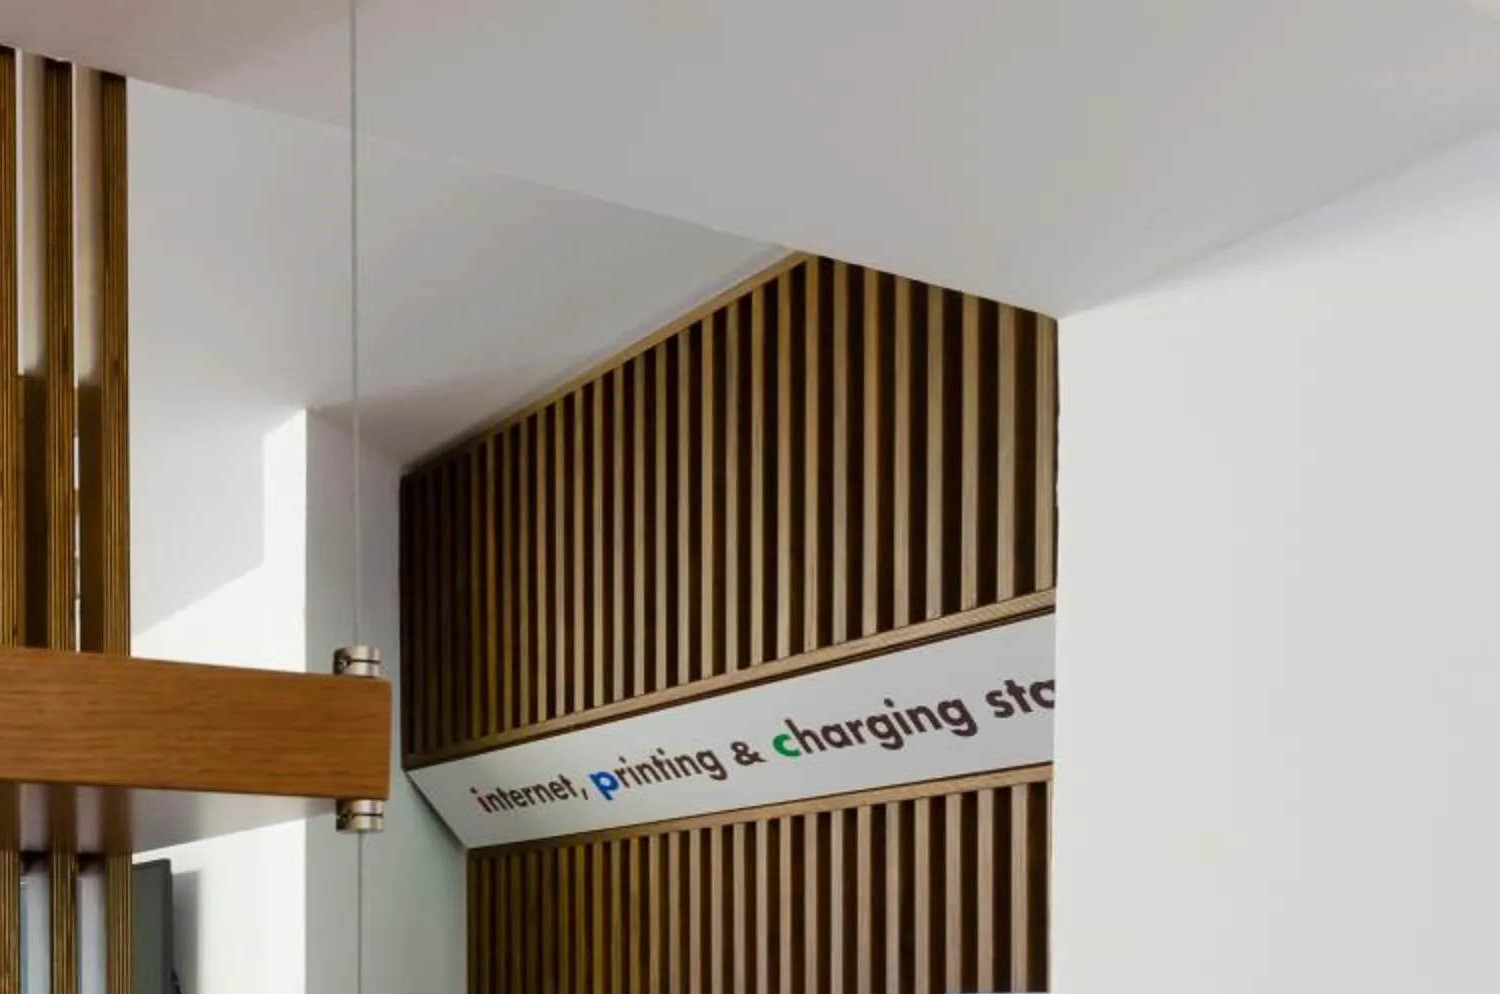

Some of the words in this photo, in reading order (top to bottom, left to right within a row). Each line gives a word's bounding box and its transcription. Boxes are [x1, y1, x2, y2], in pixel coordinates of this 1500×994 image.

[471, 773, 588, 815] internet,
[588, 738, 726, 801] printing
[731, 739, 766, 768] &
[772, 696, 976, 759] charging
